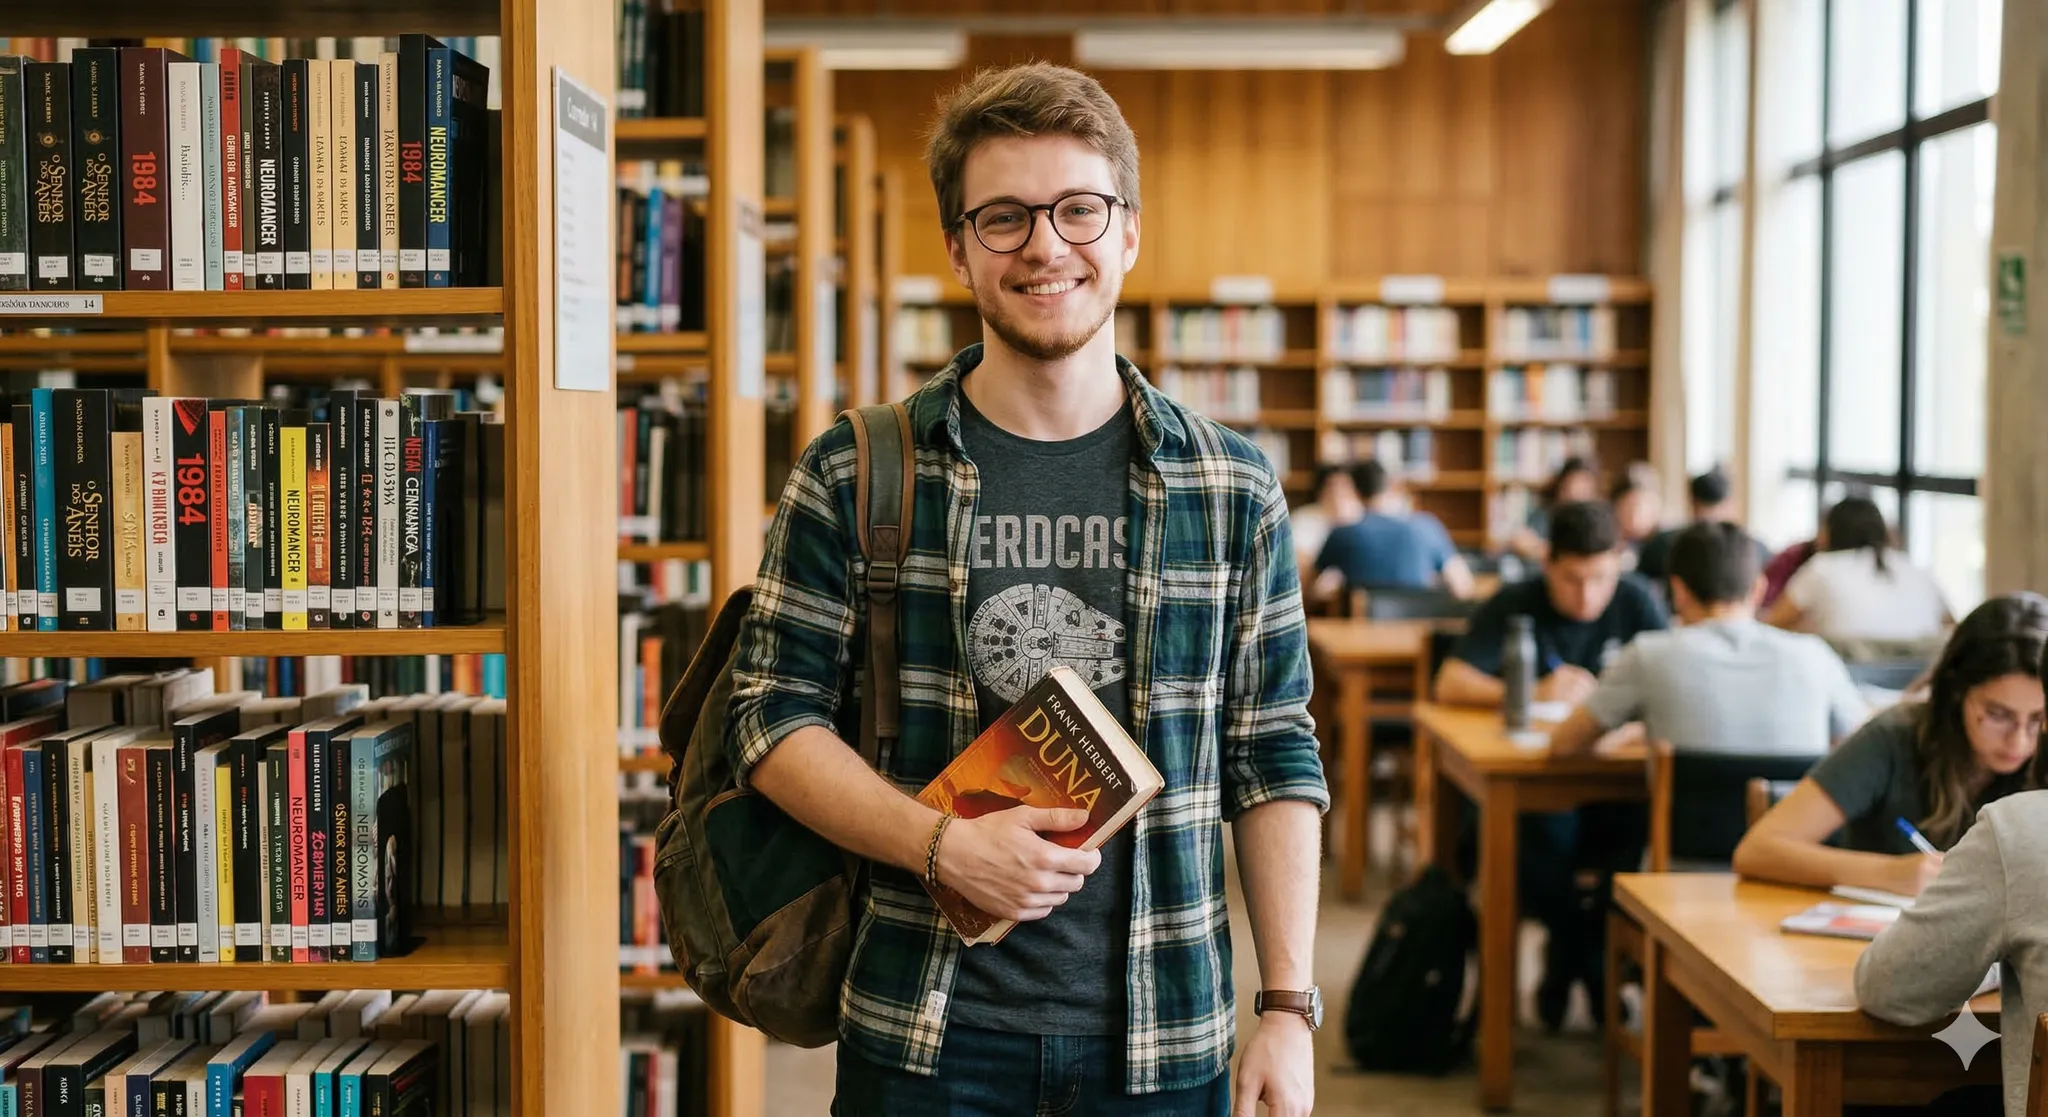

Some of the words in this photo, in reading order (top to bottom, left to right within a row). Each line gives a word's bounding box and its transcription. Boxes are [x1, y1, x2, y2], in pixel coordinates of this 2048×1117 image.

[52, 155, 60, 163] O
[86, 159, 94, 177] DOS
[98, 153, 105, 161] O
[132, 152, 157, 205] 1984
[402, 141, 422, 183] 1984
[430, 127, 446, 222] NEUROMANCER
[35, 180, 52, 222] ANÉIS
[48, 165, 65, 223] SENHOR
[81, 178, 97, 222] ANÉIS
[95, 164, 111, 222] SENHOR
[260, 159, 276, 245] NEUROMANCER
[83, 300, 95, 309] 14
[72, 484, 81, 504] DOS
[87, 481, 96, 489] O
[177, 453, 206, 525] 1984
[66, 506, 85, 557] ANÉIS
[82, 492, 102, 561] SENHOR
[287, 490, 300, 573] NEUROMANCER
[1016, 705, 1103, 816] DUNA
[1046, 694, 1081, 736] FRANK
[1078, 735, 1122, 790] HERBERT
[292, 797, 304, 900] NEUROMANCER
[335, 851, 347, 874] DOS
